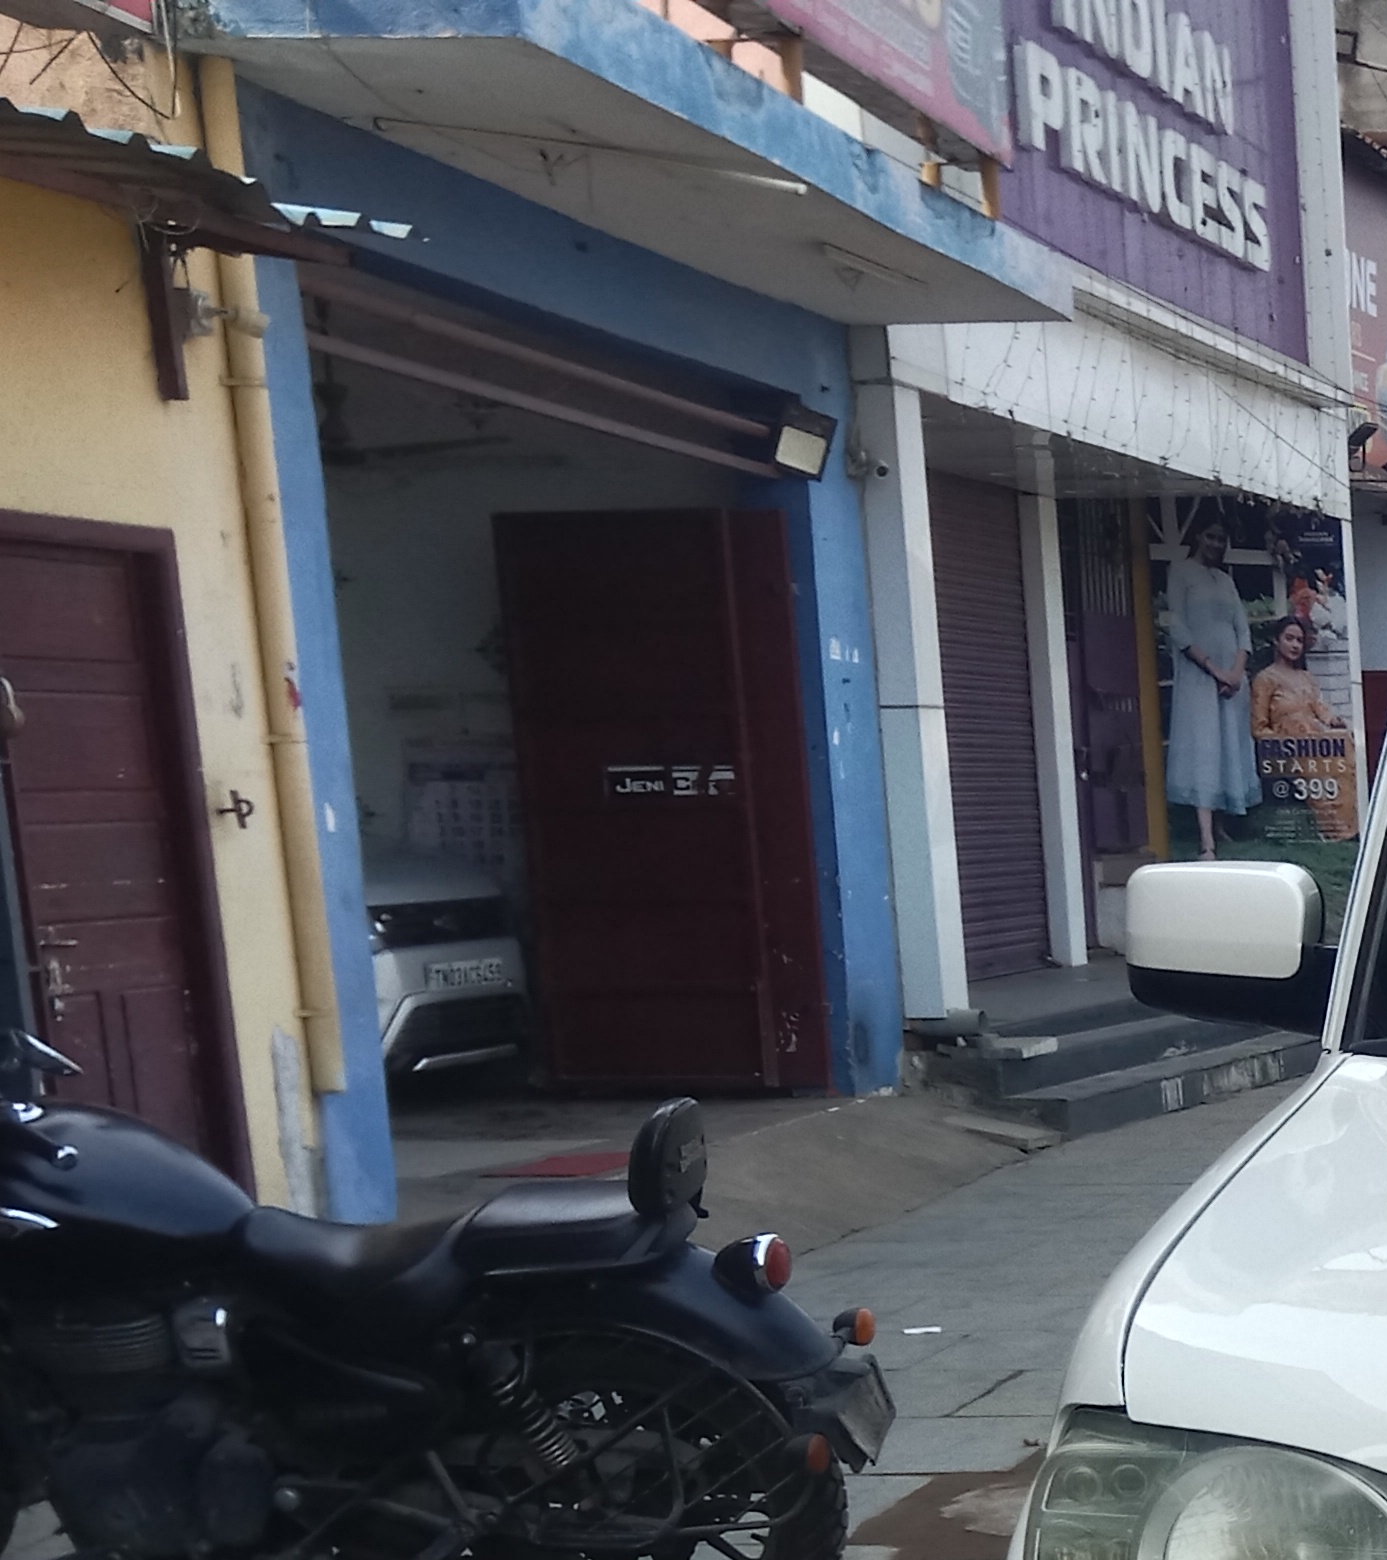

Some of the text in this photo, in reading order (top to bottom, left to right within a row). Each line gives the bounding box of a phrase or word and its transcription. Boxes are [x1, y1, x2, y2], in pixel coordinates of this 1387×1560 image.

[1016, 37, 1270, 272] PRINCESS
[1261, 737, 1345, 758] FASHION
[1262, 758, 1347, 774] STARTS
[614, 777, 665, 793] JENI
[1293, 778, 1338, 800] 399
